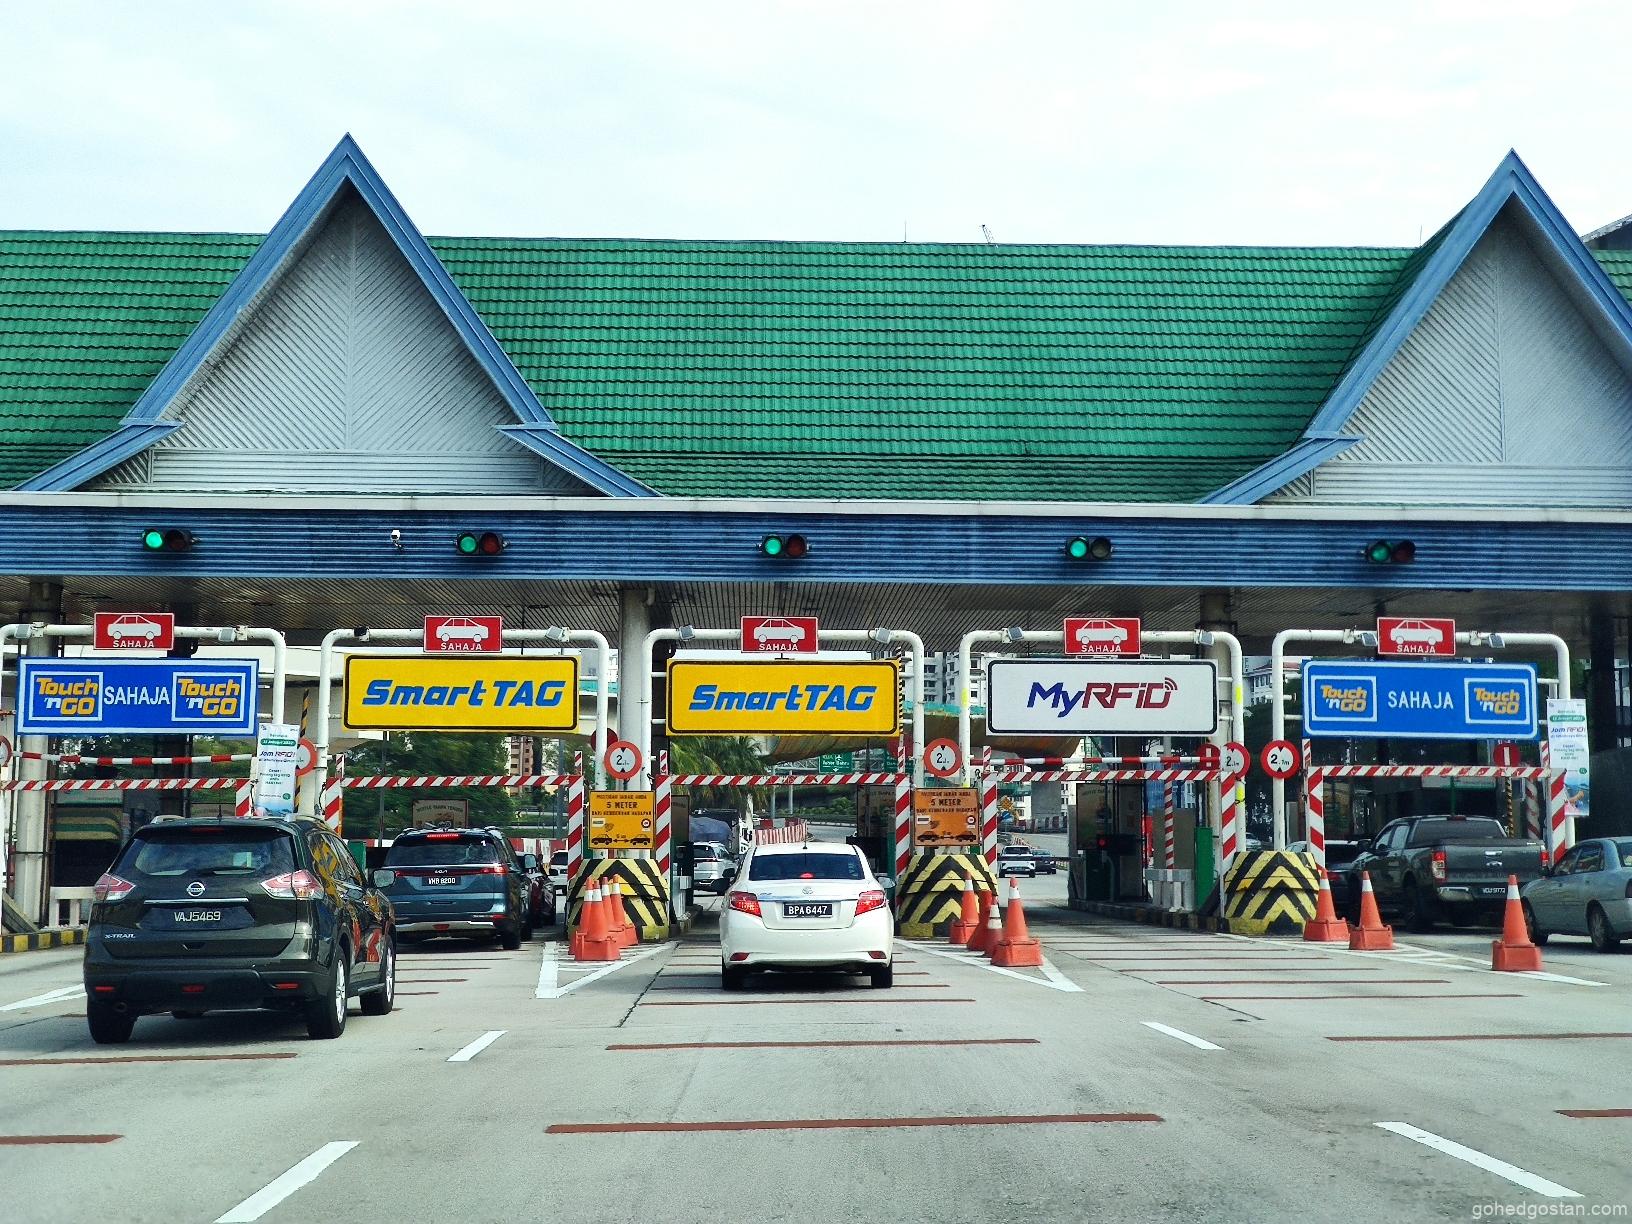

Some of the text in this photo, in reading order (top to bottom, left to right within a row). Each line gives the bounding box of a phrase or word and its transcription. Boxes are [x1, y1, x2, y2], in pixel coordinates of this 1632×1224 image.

[113, 640, 154, 648] SAHAJA
[441, 643, 482, 651] SAHAJA
[1081, 645, 1121, 653] SAHAJA
[1397, 645, 1436, 653] SAHAJA
[36, 677, 98, 696] Touch
[178, 678, 240, 696] Touch
[1320, 685, 1368, 699] Touch
[104, 686, 171, 705] SAHAJA
[1388, 691, 1454, 709] SAHAJA
[1474, 688, 1520, 701] Touch
[606, 801, 638, 809] 5 METER
[174, 911, 221, 922] VAJ5469
